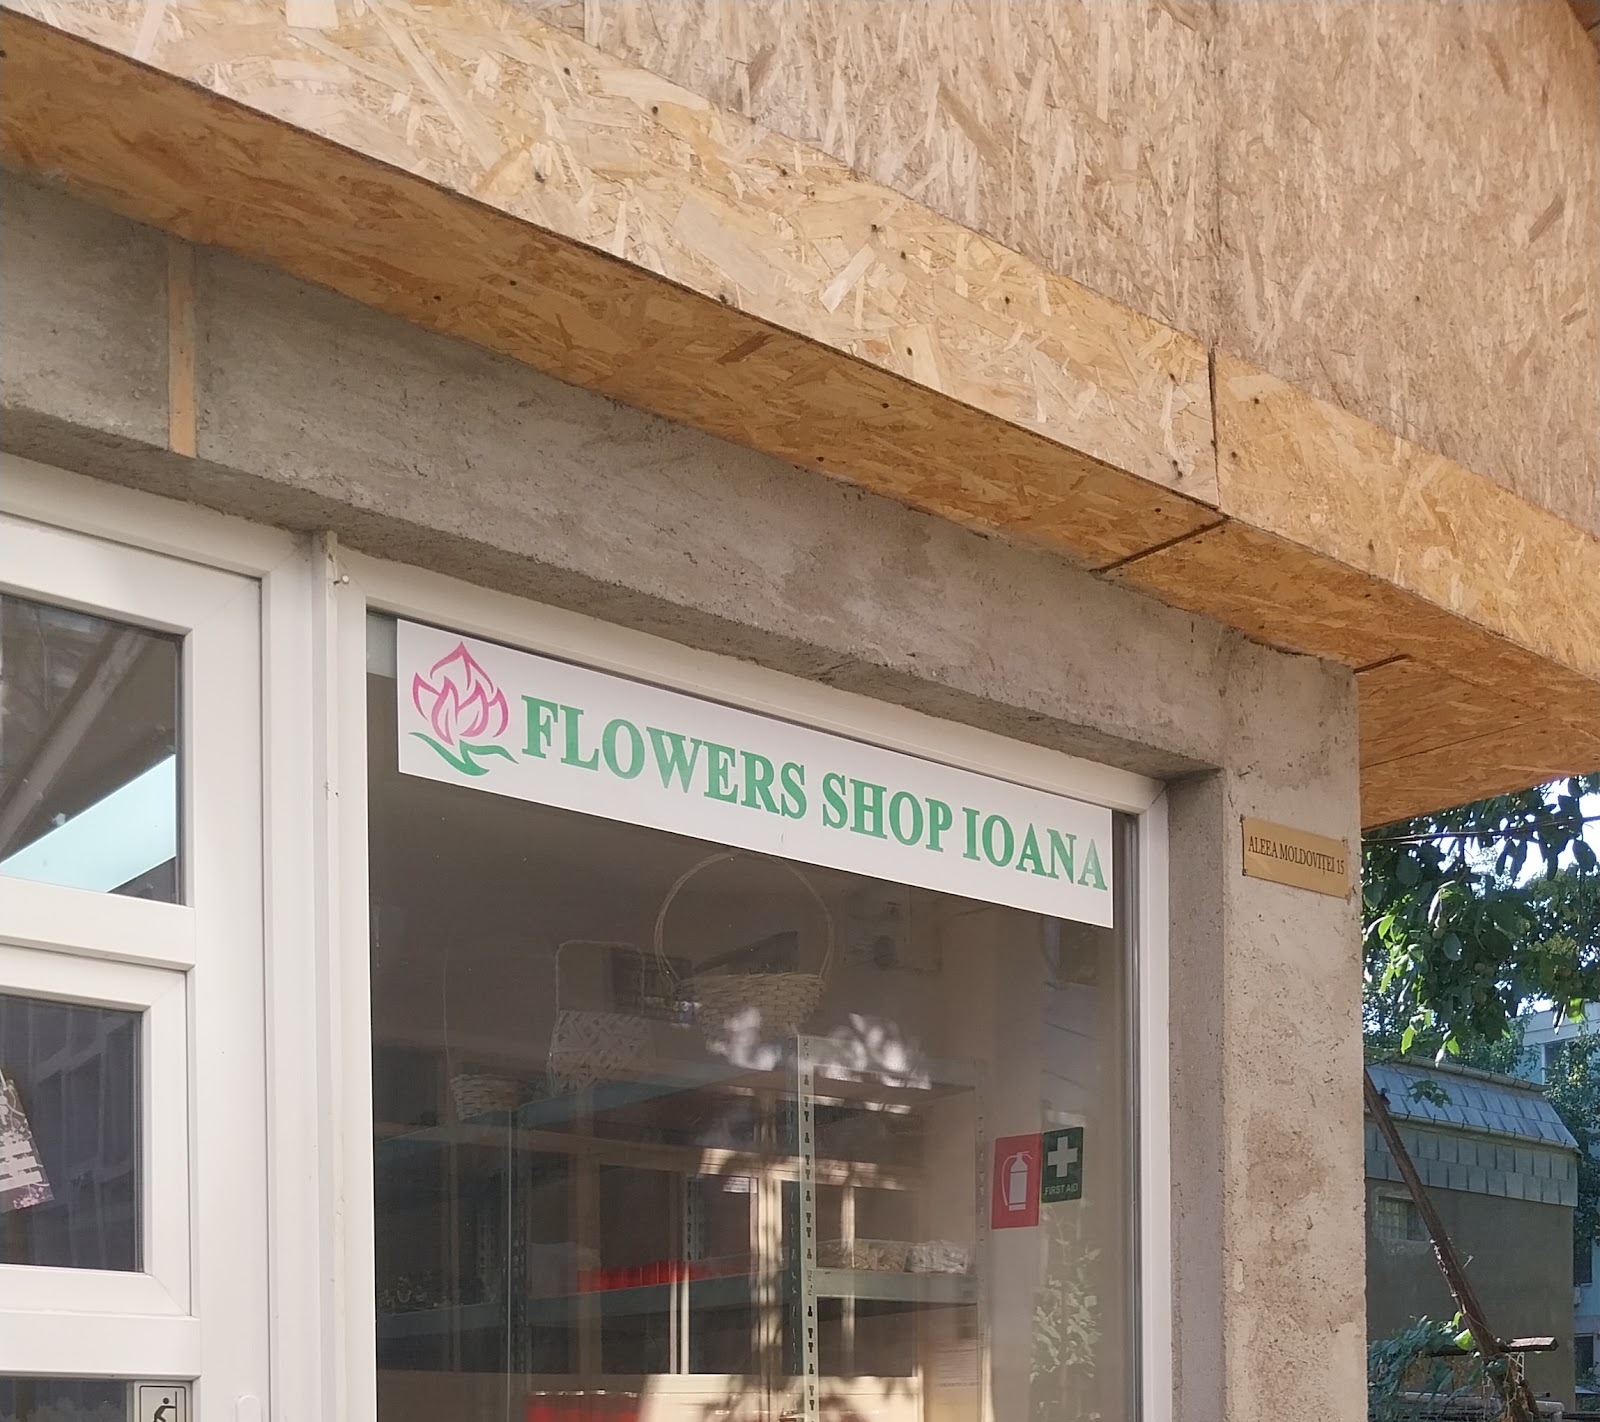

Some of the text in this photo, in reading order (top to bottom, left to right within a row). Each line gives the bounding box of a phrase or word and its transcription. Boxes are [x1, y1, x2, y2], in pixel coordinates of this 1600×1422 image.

[521, 694, 1108, 891] FLOWERS SHOP IOANA
[1248, 835, 1278, 859] ALEEA
[1336, 859, 1345, 875] 15
[1044, 1183, 1079, 1196] FIRST AID
